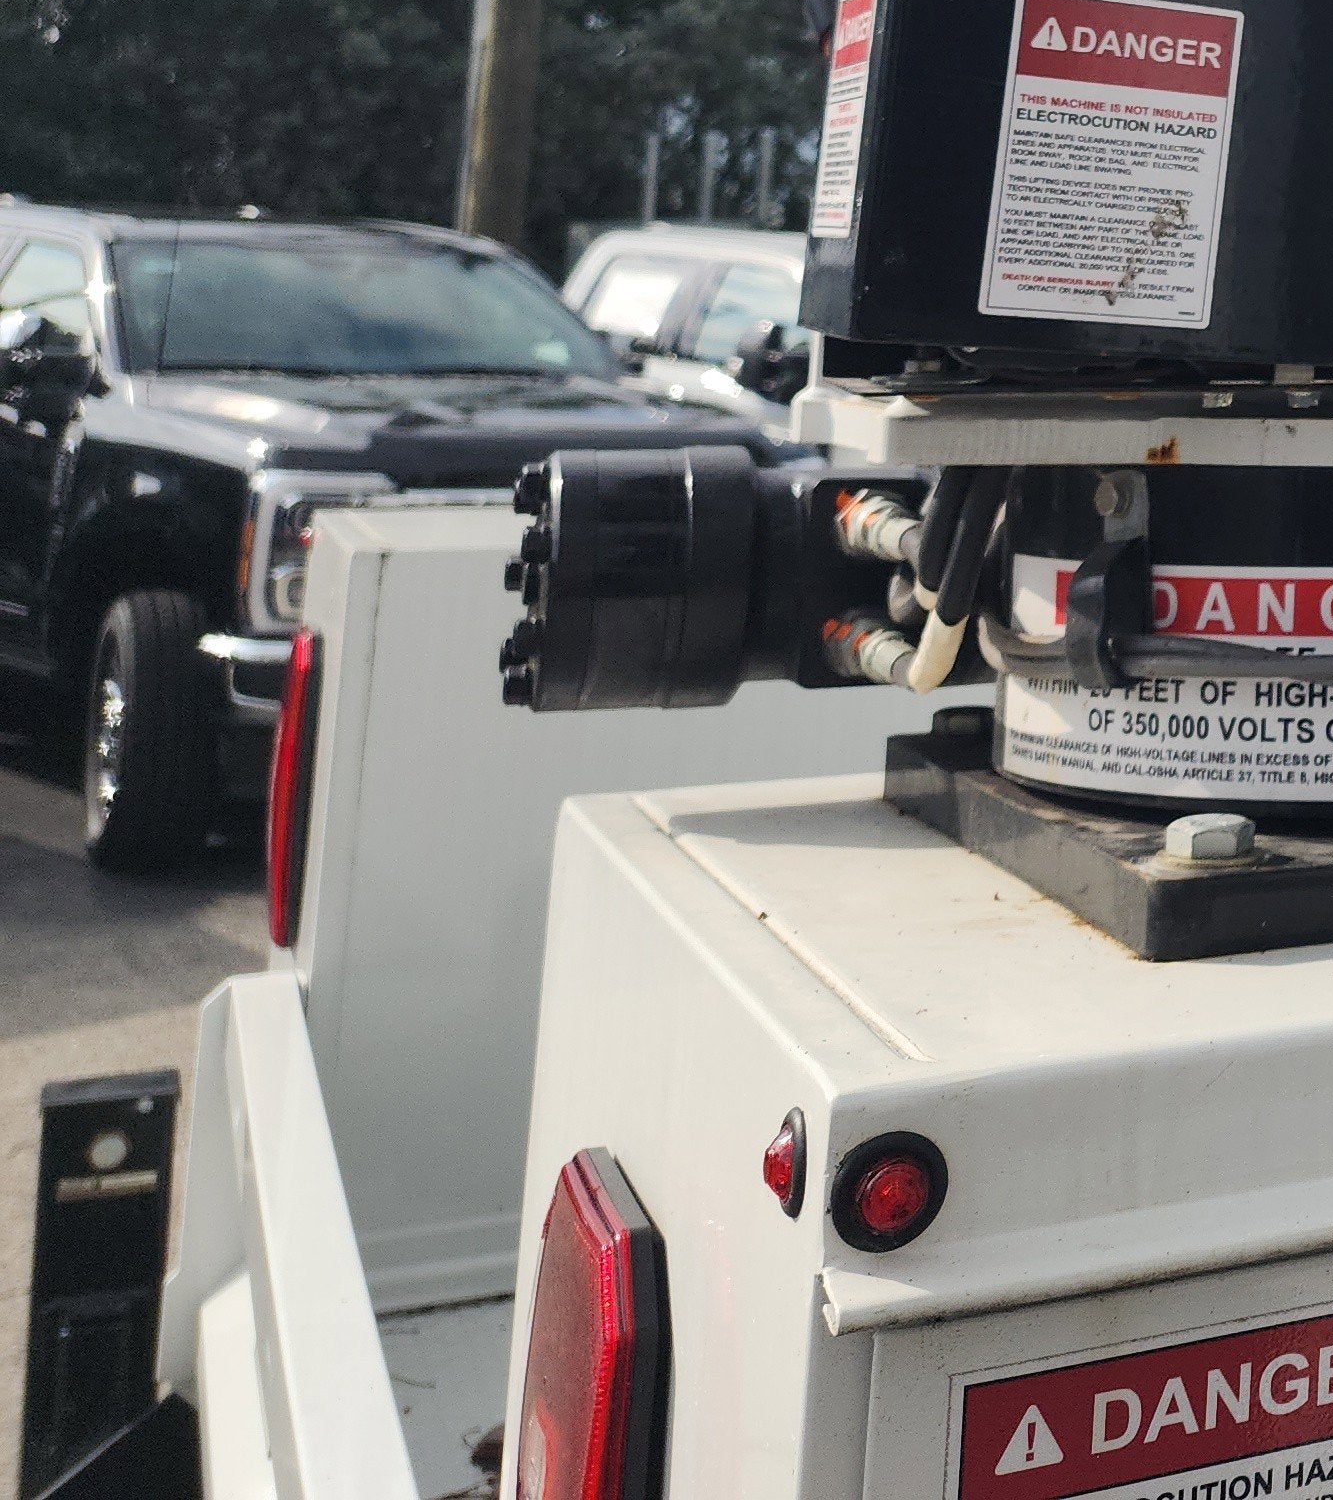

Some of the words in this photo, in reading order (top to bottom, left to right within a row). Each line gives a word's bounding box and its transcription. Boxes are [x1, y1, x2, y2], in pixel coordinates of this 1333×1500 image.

[1072, 25, 1223, 69] DANGER
[1019, 93, 1047, 105] THIS
[1051, 96, 1108, 112] MACHINE
[1110, 102, 1121, 112] IS
[1125, 104, 1150, 116] NOT
[1152, 108, 1218, 123] INSULATED
[1016, 107, 1151, 132] ELECTROCUTION
[1154, 122, 1218, 140] HAZARD
[1200, 680, 1237, 706] OF
[1089, 708, 1115, 732] OF
[1122, 711, 1210, 742] 350,000
[1218, 716, 1316, 744] VOLTS
[1045, 737, 1099, 754] CLEARANCES
[1101, 744, 1113, 755] OF
[1116, 746, 1199, 763] HIGH-VOLTAGE
[1200, 750, 1237, 765] LINES
[1240, 752, 1253, 766] IN
[1255, 752, 1310, 767] EXCESS
[1313, 753, 1332, 767] OF
[1101, 761, 1122, 774] AND
[1182, 768, 1234, 782] ARTICLE
[1258, 770, 1295, 783] TITLE
